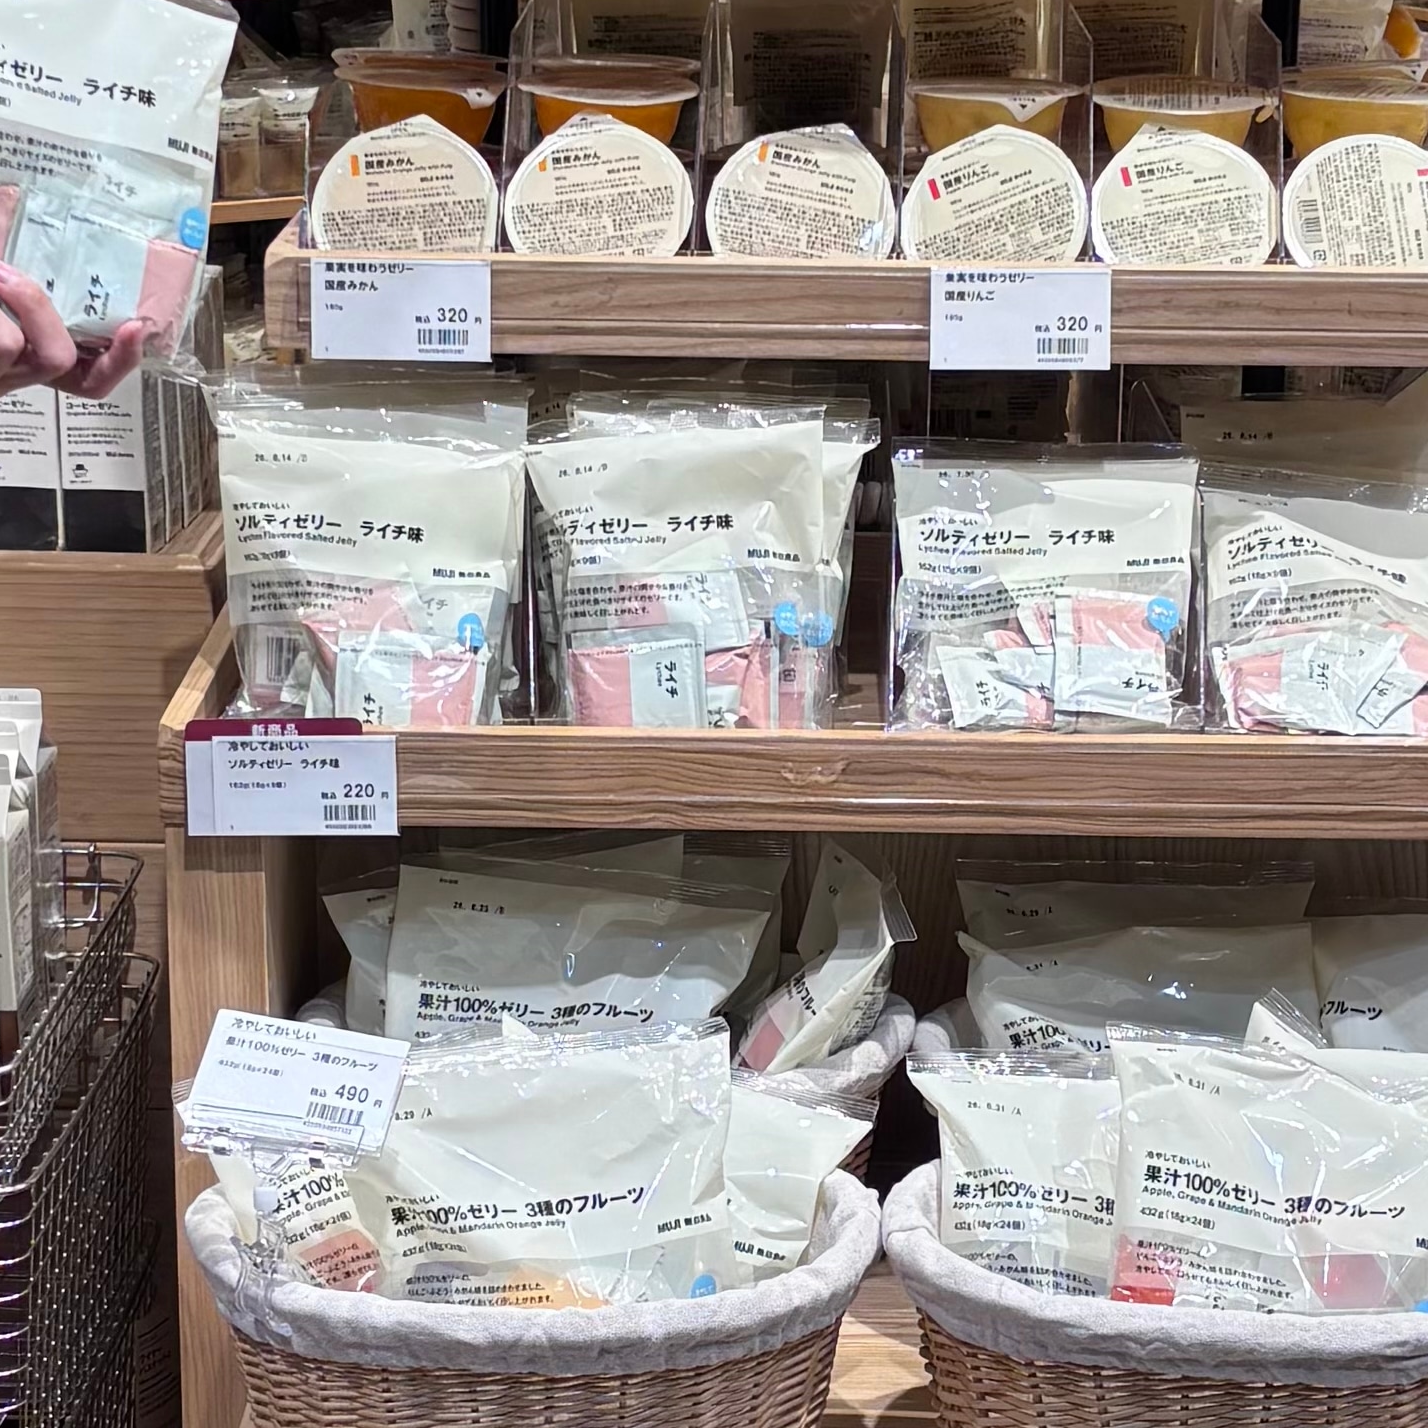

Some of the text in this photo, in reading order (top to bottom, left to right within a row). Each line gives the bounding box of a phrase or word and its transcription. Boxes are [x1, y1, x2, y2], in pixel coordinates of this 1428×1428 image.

[83, 78, 156, 108] ライチ味
[324, 262, 414, 273] 果実を味わうゼリー
[324, 280, 379, 292] 国産みかん
[945, 272, 1035, 284] 果実を味わうゼリー
[944, 290, 995, 302] 国産りんご
[437, 307, 468, 323] 320
[1056, 316, 1089, 332] 320
[235, 514, 425, 544] ソルティゼリー ライチ味
[667, 514, 733, 533] ライチ味
[920, 529, 1115, 546] ソルティゼリー ライチ味
[747, 549, 770, 559] MUJI
[432, 567, 455, 578] MUJI
[664, 660, 679, 698] ライチ
[228, 740, 310, 752] 冷やしておいしい
[228, 758, 340, 769] ソルティゼリー ライチ味
[343, 783, 374, 798] 220
[551, 1002, 654, 1023] 3種のフルーツ
[232, 1017, 317, 1040] 冷やしておいしい
[335, 1084, 369, 1103] 490
[373, 1099, 383, 1108] 円
[1144, 1163, 1406, 1220] 果汁100%ゼリー 3種のフルーツ
[524, 1186, 648, 1220] 3種のフルーツ
